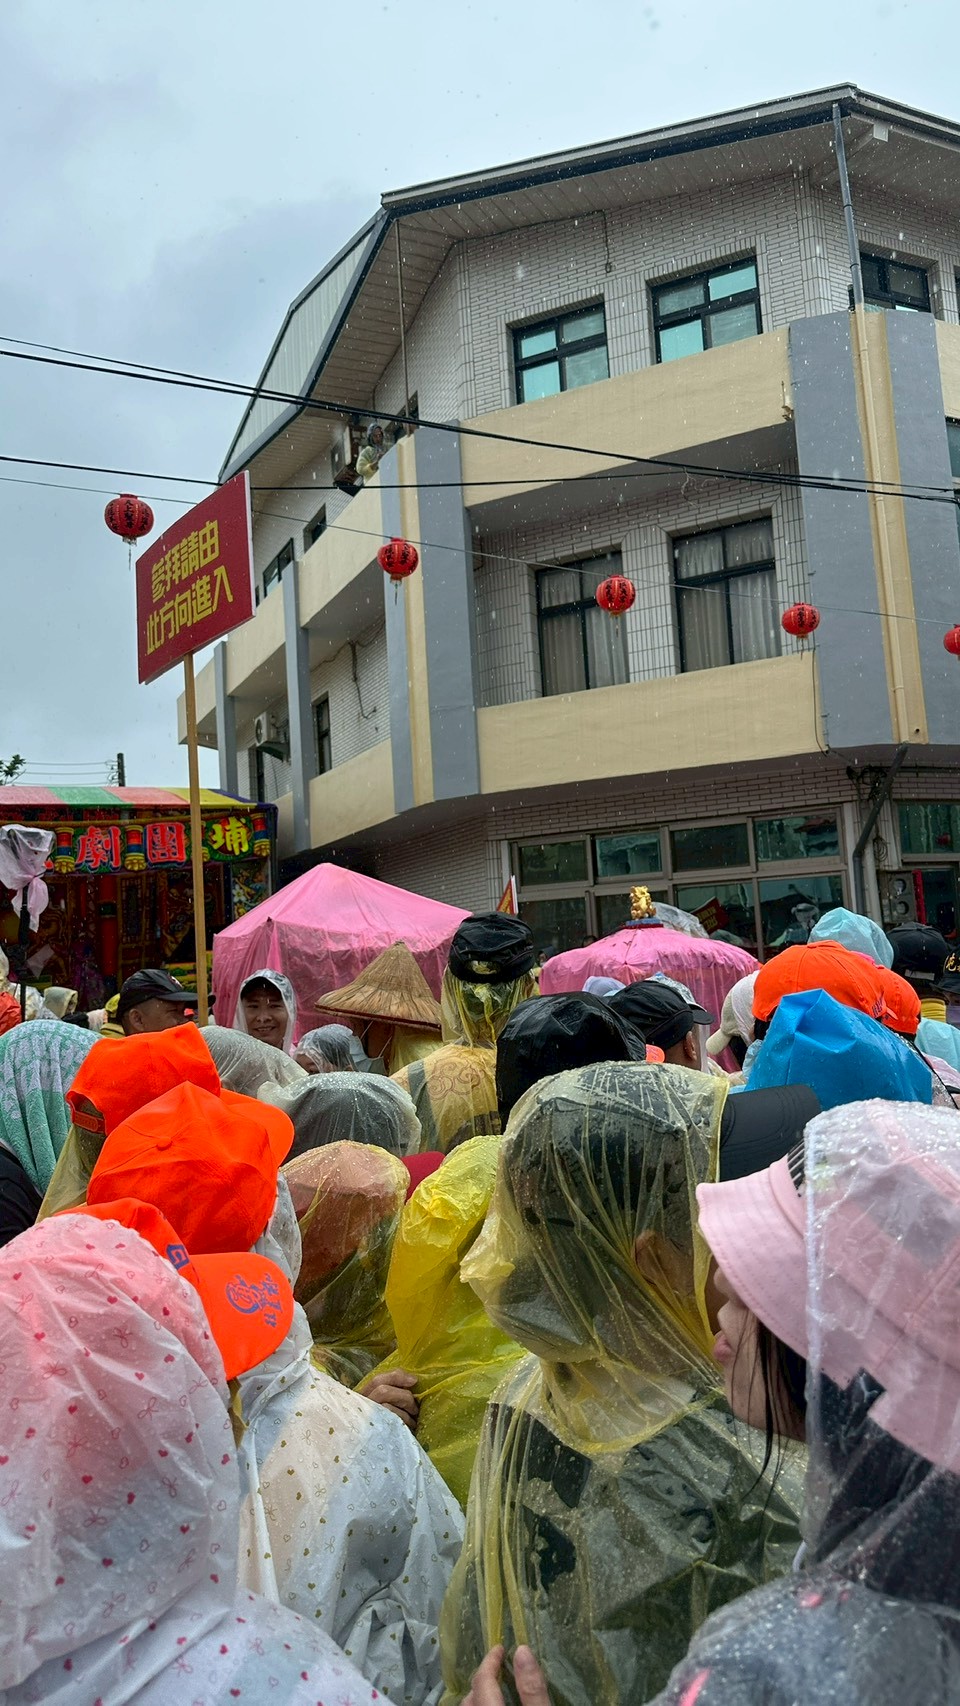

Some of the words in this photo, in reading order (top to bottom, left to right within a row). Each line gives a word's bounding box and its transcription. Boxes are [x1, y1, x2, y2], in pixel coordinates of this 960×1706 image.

[152, 520, 220, 603] 參拜請由
[146, 565, 233, 656] 此方向進入
